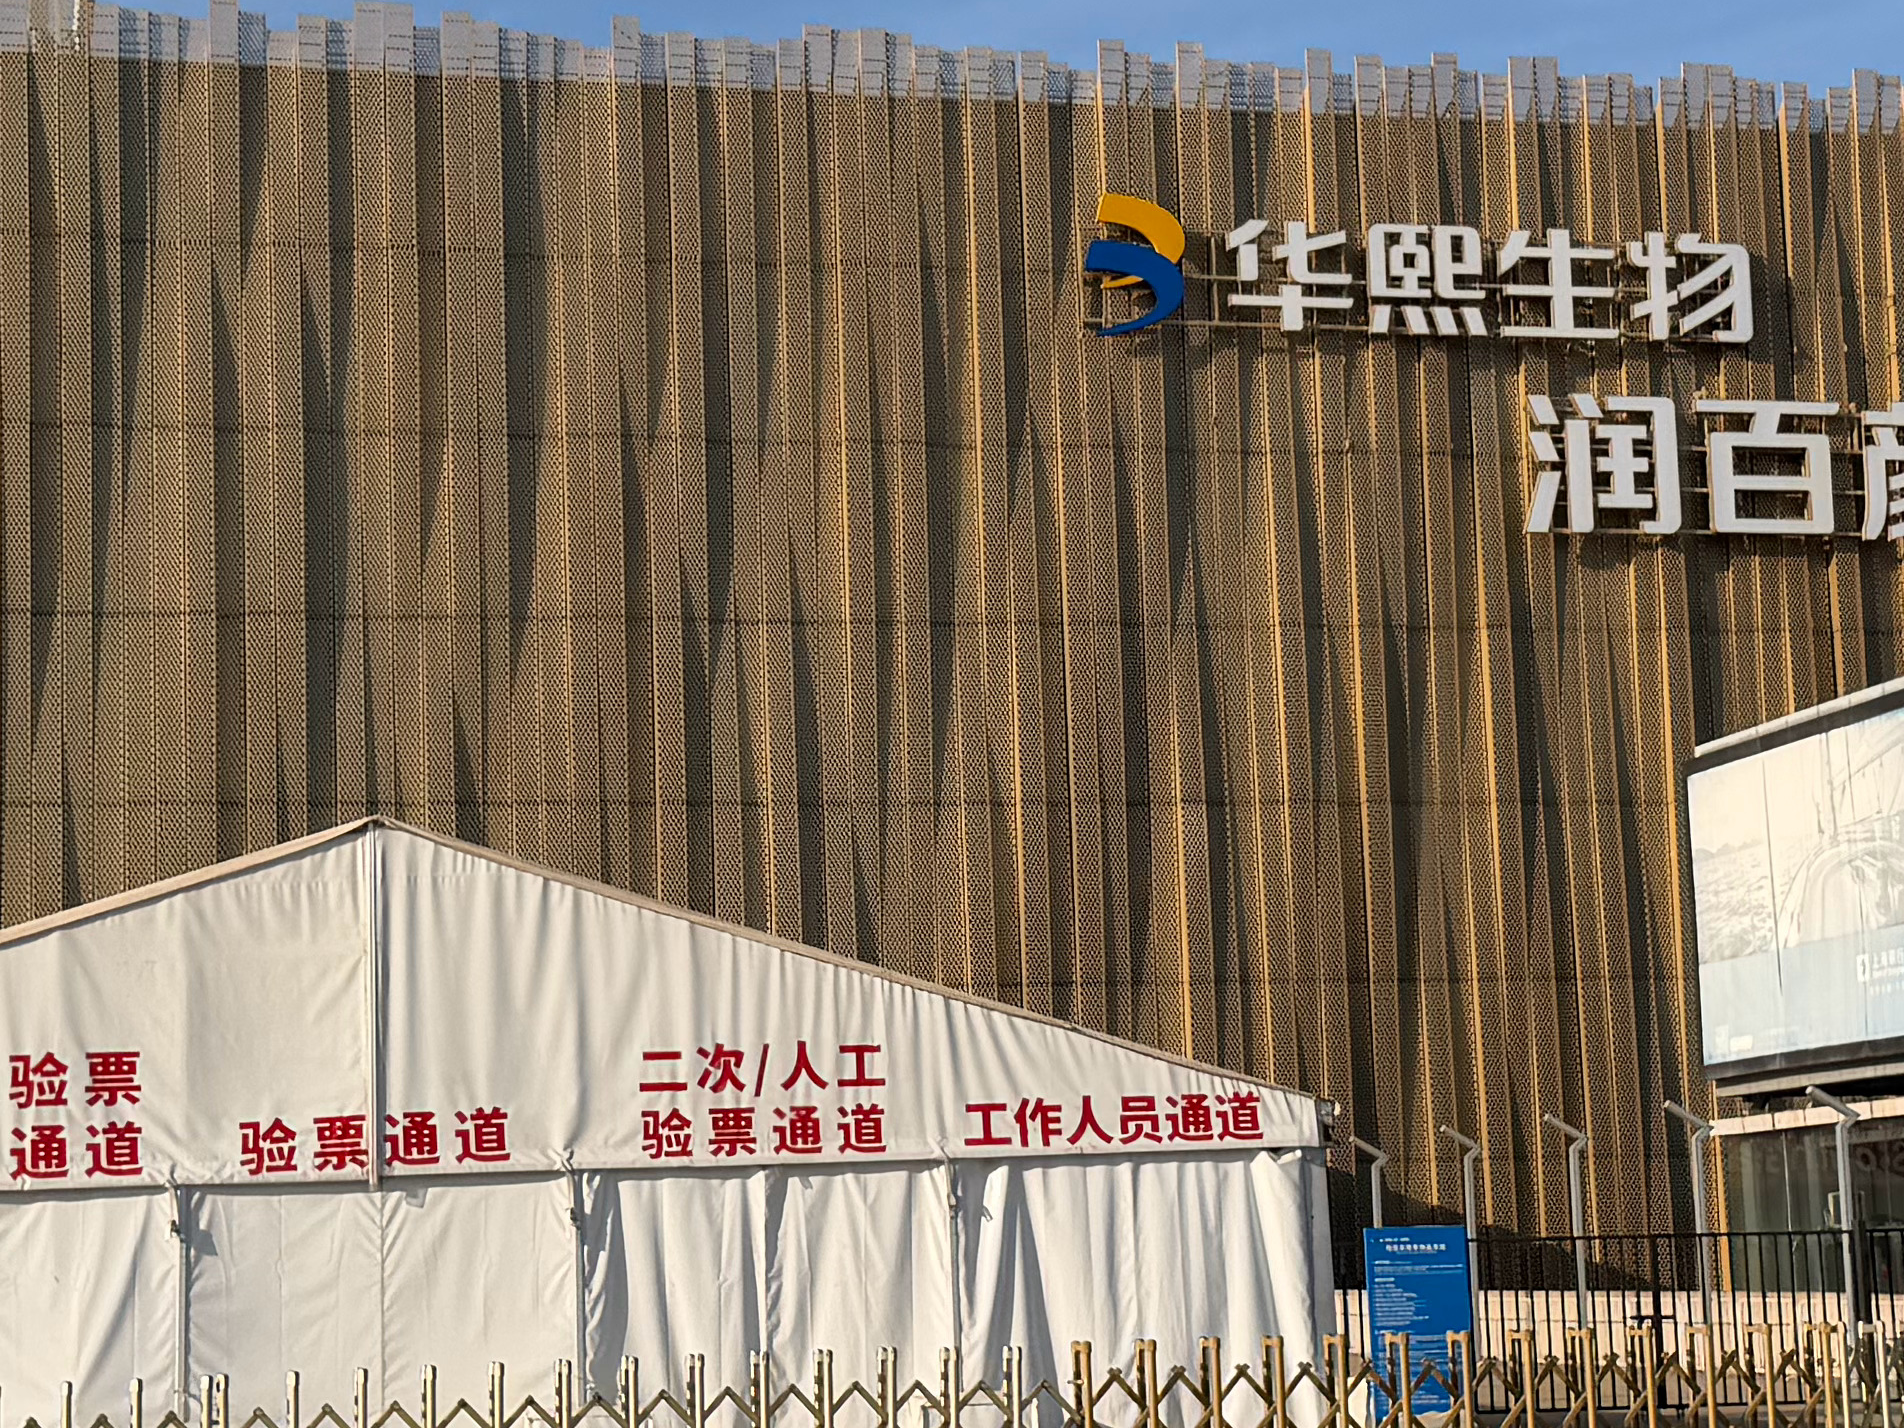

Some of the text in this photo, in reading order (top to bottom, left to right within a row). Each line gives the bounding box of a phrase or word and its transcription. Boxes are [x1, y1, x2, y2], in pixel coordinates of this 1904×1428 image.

[1225, 220, 1755, 343] 华熙生物
[9, 1052, 143, 1109] 验票
[639, 1041, 887, 1097] 二次/人工
[239, 1107, 512, 1177] 验票通道
[642, 1103, 887, 1161] 验票通道
[965, 1091, 1265, 1149] 工作人员通道
[9, 1121, 143, 1181] 通道
